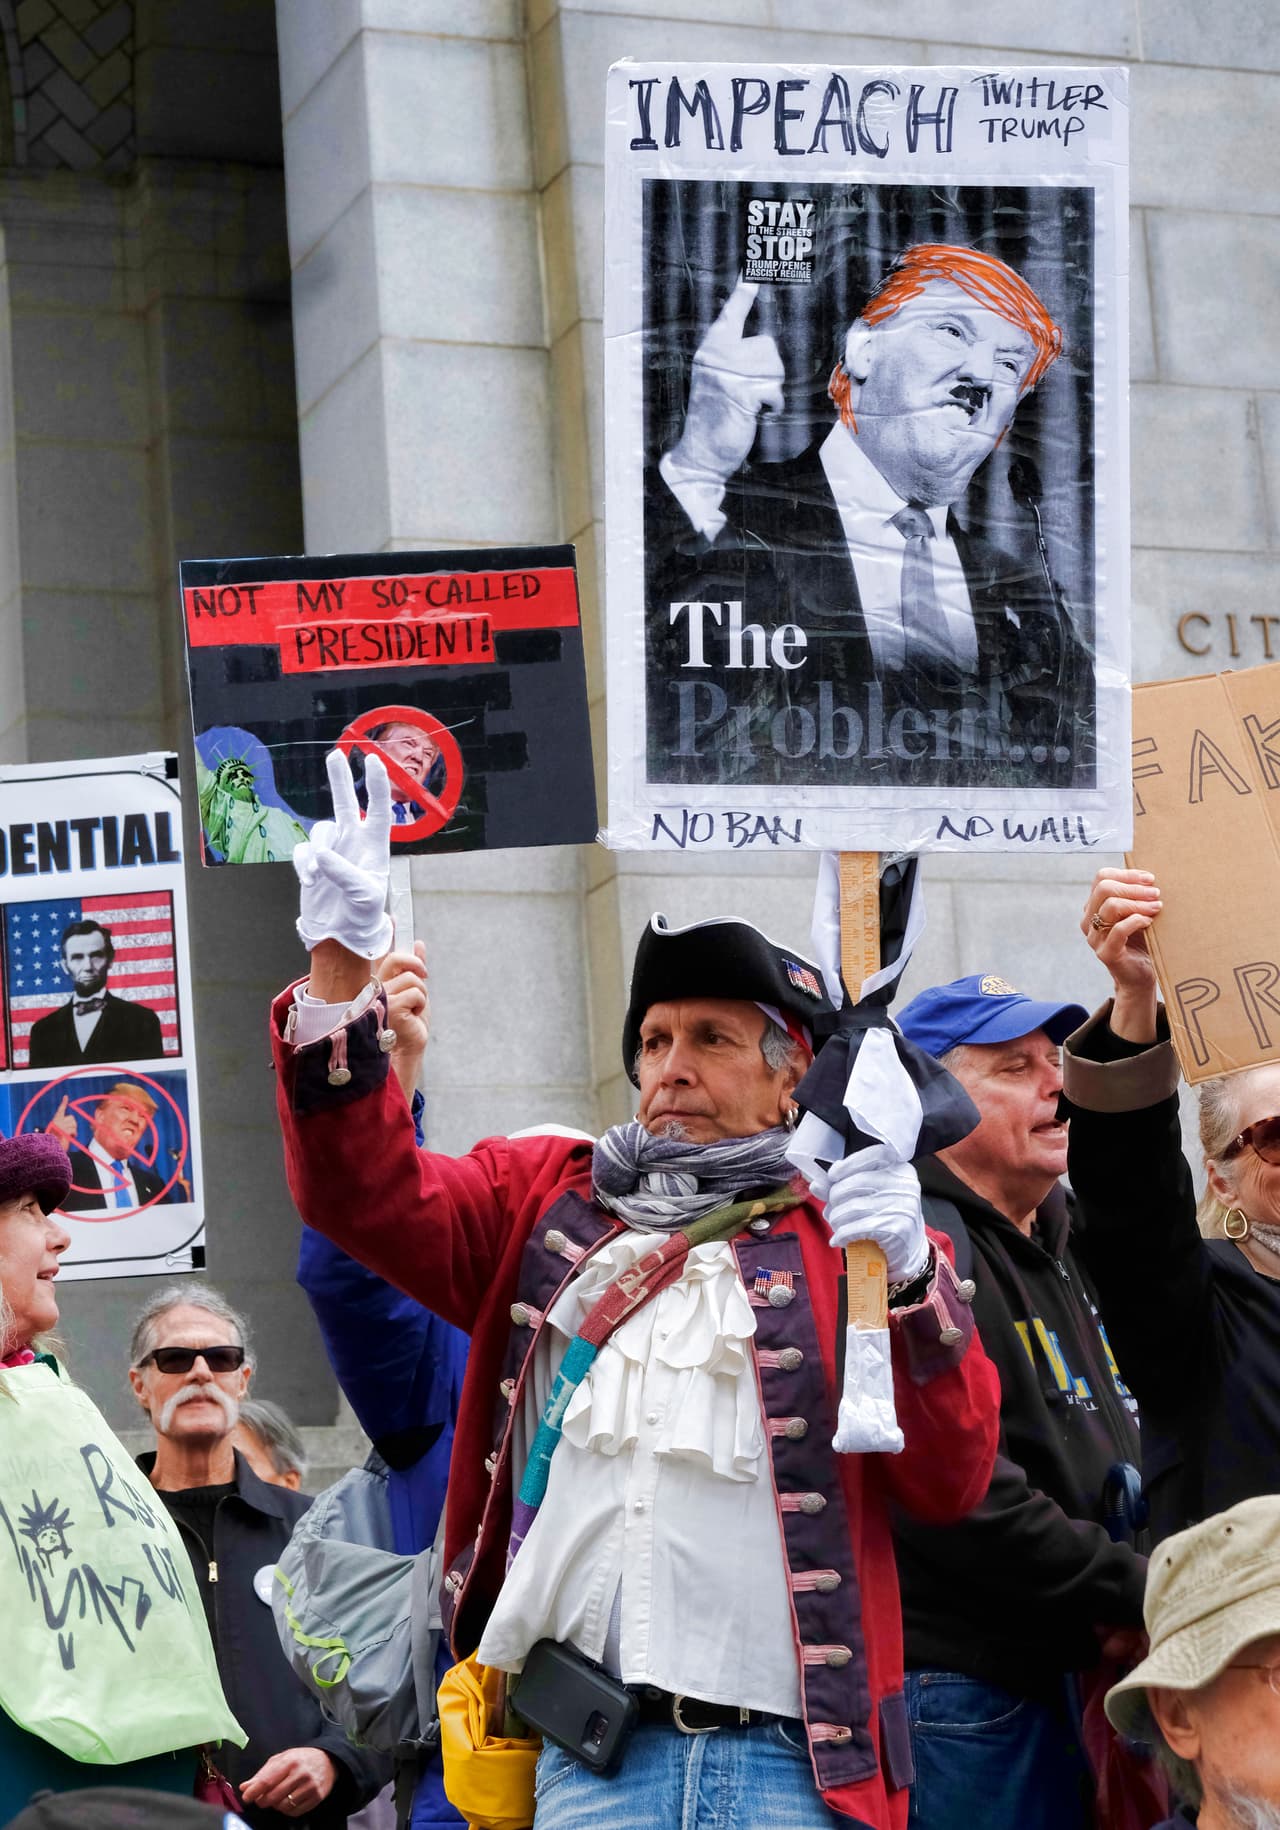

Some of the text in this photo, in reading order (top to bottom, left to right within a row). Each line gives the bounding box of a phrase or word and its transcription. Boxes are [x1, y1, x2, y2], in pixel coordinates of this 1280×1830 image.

[971, 73, 1108, 110] TWITLER
[629, 73, 958, 158] IMPEACH
[979, 116, 1085, 146] TRUMP
[748, 200, 813, 228] STAY
[748, 225, 812, 237] IN THE STREETS
[746, 234, 813, 261] STOP
[746, 259, 812, 271] TRUMP/PENCE
[746, 268, 811, 279] FASCIST REGIME
[194, 573, 541, 618] NOT MY SO-CALLED
[295, 619, 490, 666] PRESIDENT!
[670, 601, 808, 669] The
[0, 811, 180, 877] ENTIAL
[651, 810, 802, 849] NO BAN
[937, 815, 1100, 847] NO WALL
